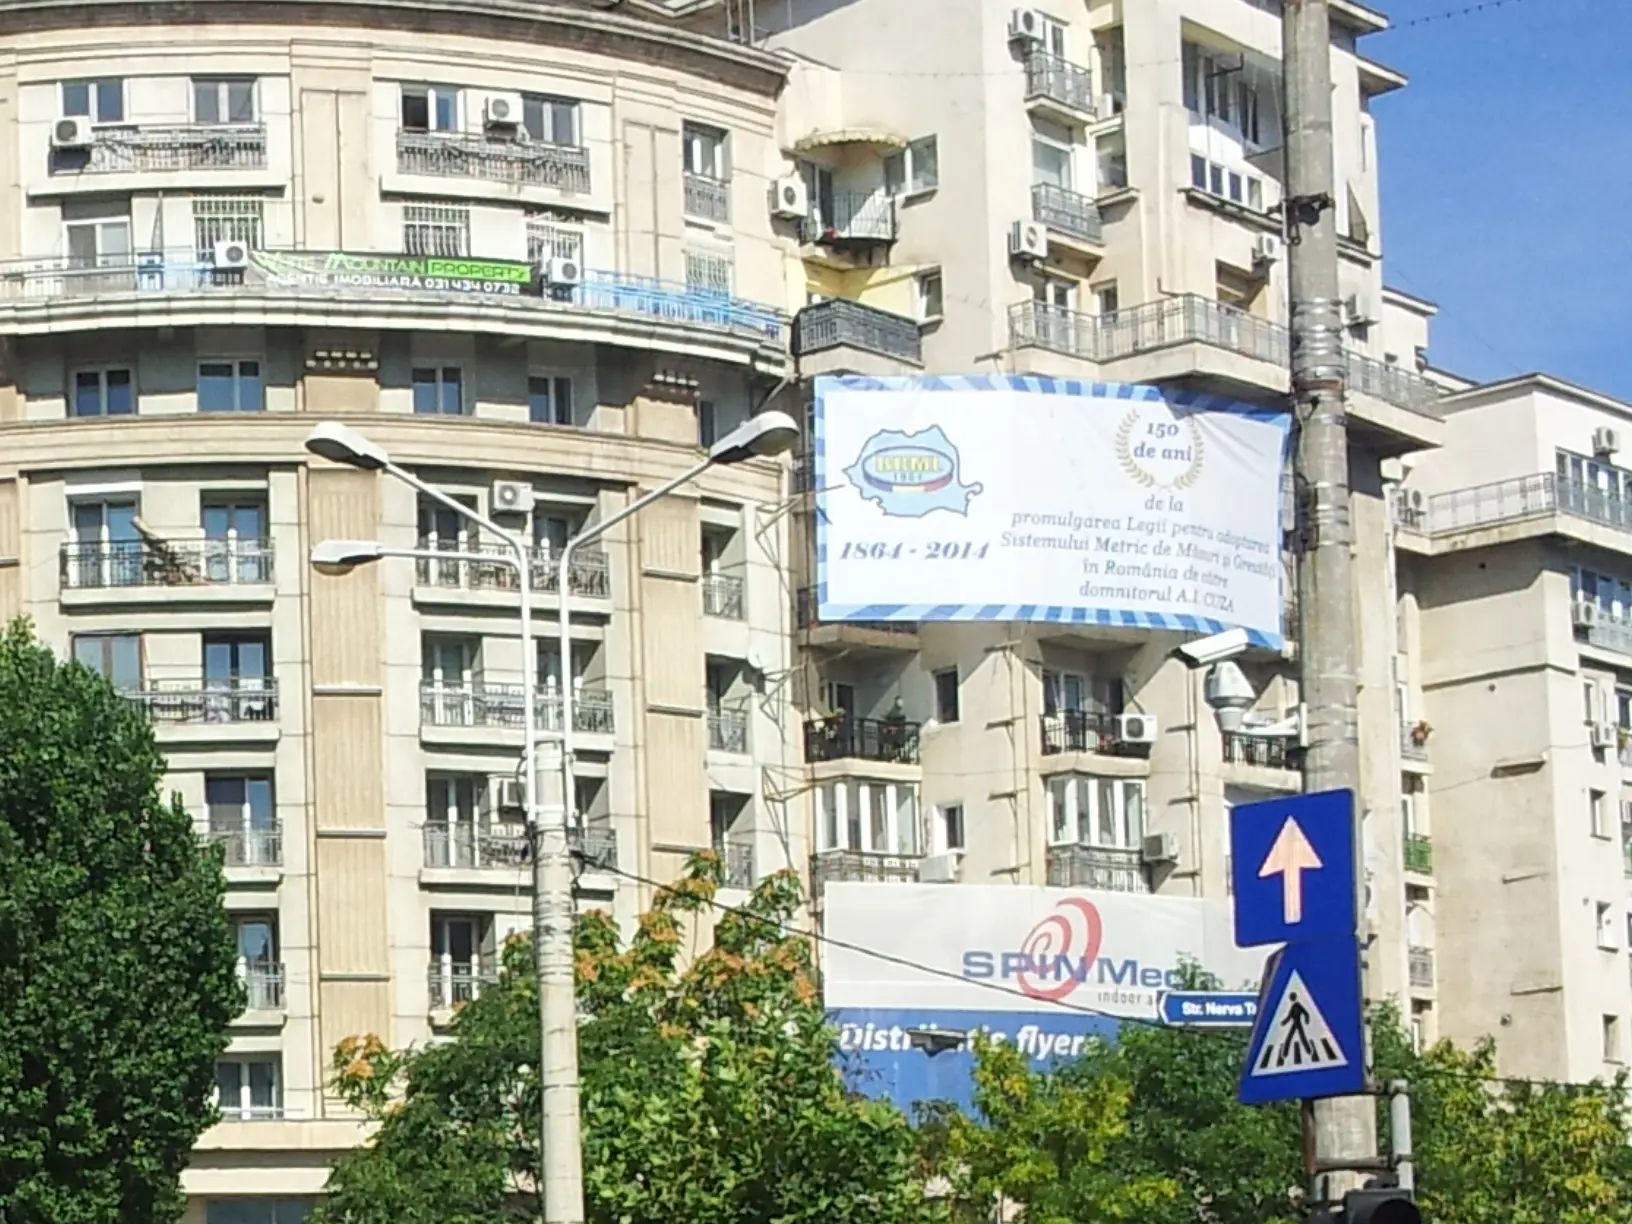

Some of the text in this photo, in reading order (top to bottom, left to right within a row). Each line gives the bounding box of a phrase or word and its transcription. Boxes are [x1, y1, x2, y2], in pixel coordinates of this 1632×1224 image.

[1146, 421, 1179, 439] 150
[1133, 441, 1192, 462] de ani
[1144, 494, 1184, 512] de la
[1011, 511, 1121, 532] promulgarea
[1127, 516, 1167, 536] Legii
[840, 541, 904, 559] 1864
[925, 541, 990, 559] 2014
[1000, 531, 1089, 551] Sistemului
[1094, 536, 1148, 556] Metric
[1153, 539, 1172, 557] de
[1104, 559, 1178, 579] România
[1079, 580, 1171, 602] domnitorul
[1206, 1002, 1242, 1016] Nerva
